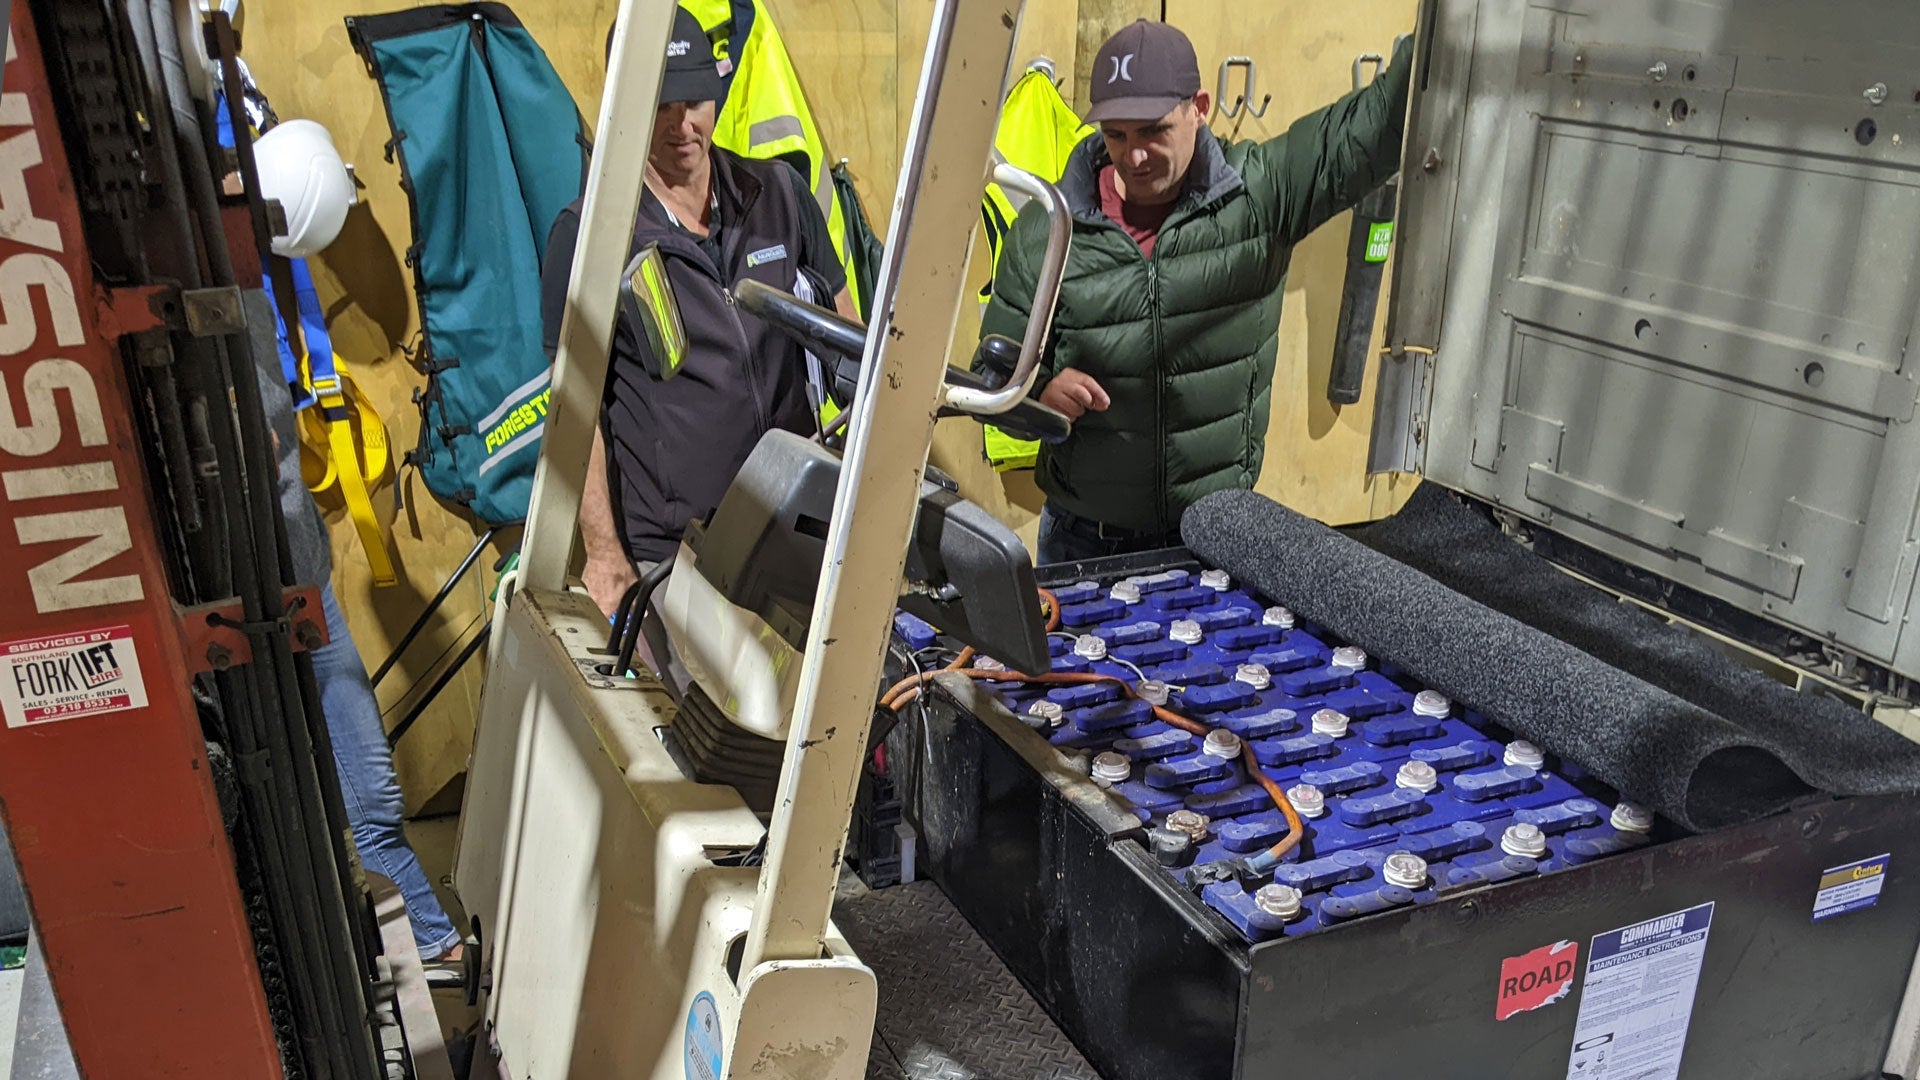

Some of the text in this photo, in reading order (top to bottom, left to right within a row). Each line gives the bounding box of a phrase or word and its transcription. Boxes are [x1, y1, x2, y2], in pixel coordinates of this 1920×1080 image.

[8, 631, 111, 653] SERVICED BY
[11, 650, 69, 664] SOUTHLAND
[90, 668, 123, 684] HIRE
[22, 688, 128, 709] SALES SERVICE RENTAL
[43, 698, 111, 715] 03 218 8533
[1852, 863, 1883, 880] Century
[1621, 913, 1686, 944] COMMANDER
[1593, 948, 1648, 971] MAINTENANCE
[1648, 933, 1702, 955] INSTRUCTIONS
[1503, 960, 1572, 998] ROAD
